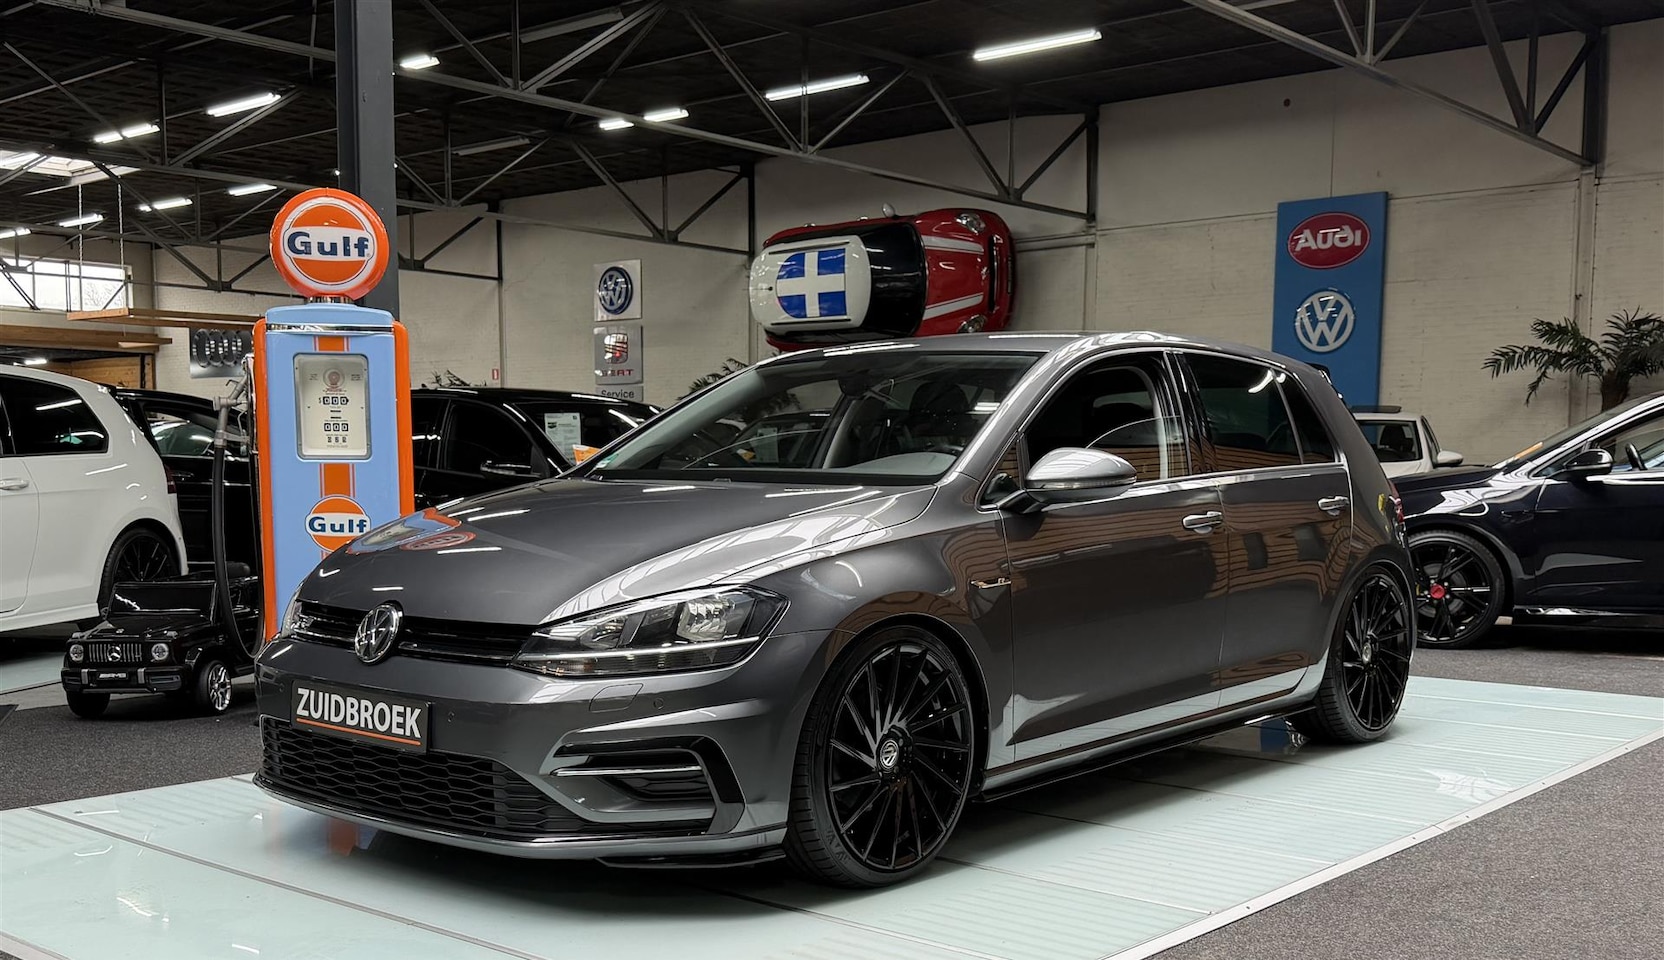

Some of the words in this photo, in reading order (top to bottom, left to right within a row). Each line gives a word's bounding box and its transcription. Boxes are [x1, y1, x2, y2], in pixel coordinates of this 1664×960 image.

[287, 231, 369, 257] Gulf
[601, 389, 635, 398] Service
[308, 516, 367, 533] Gulf
[296, 687, 421, 738] ZUIDBROEK
